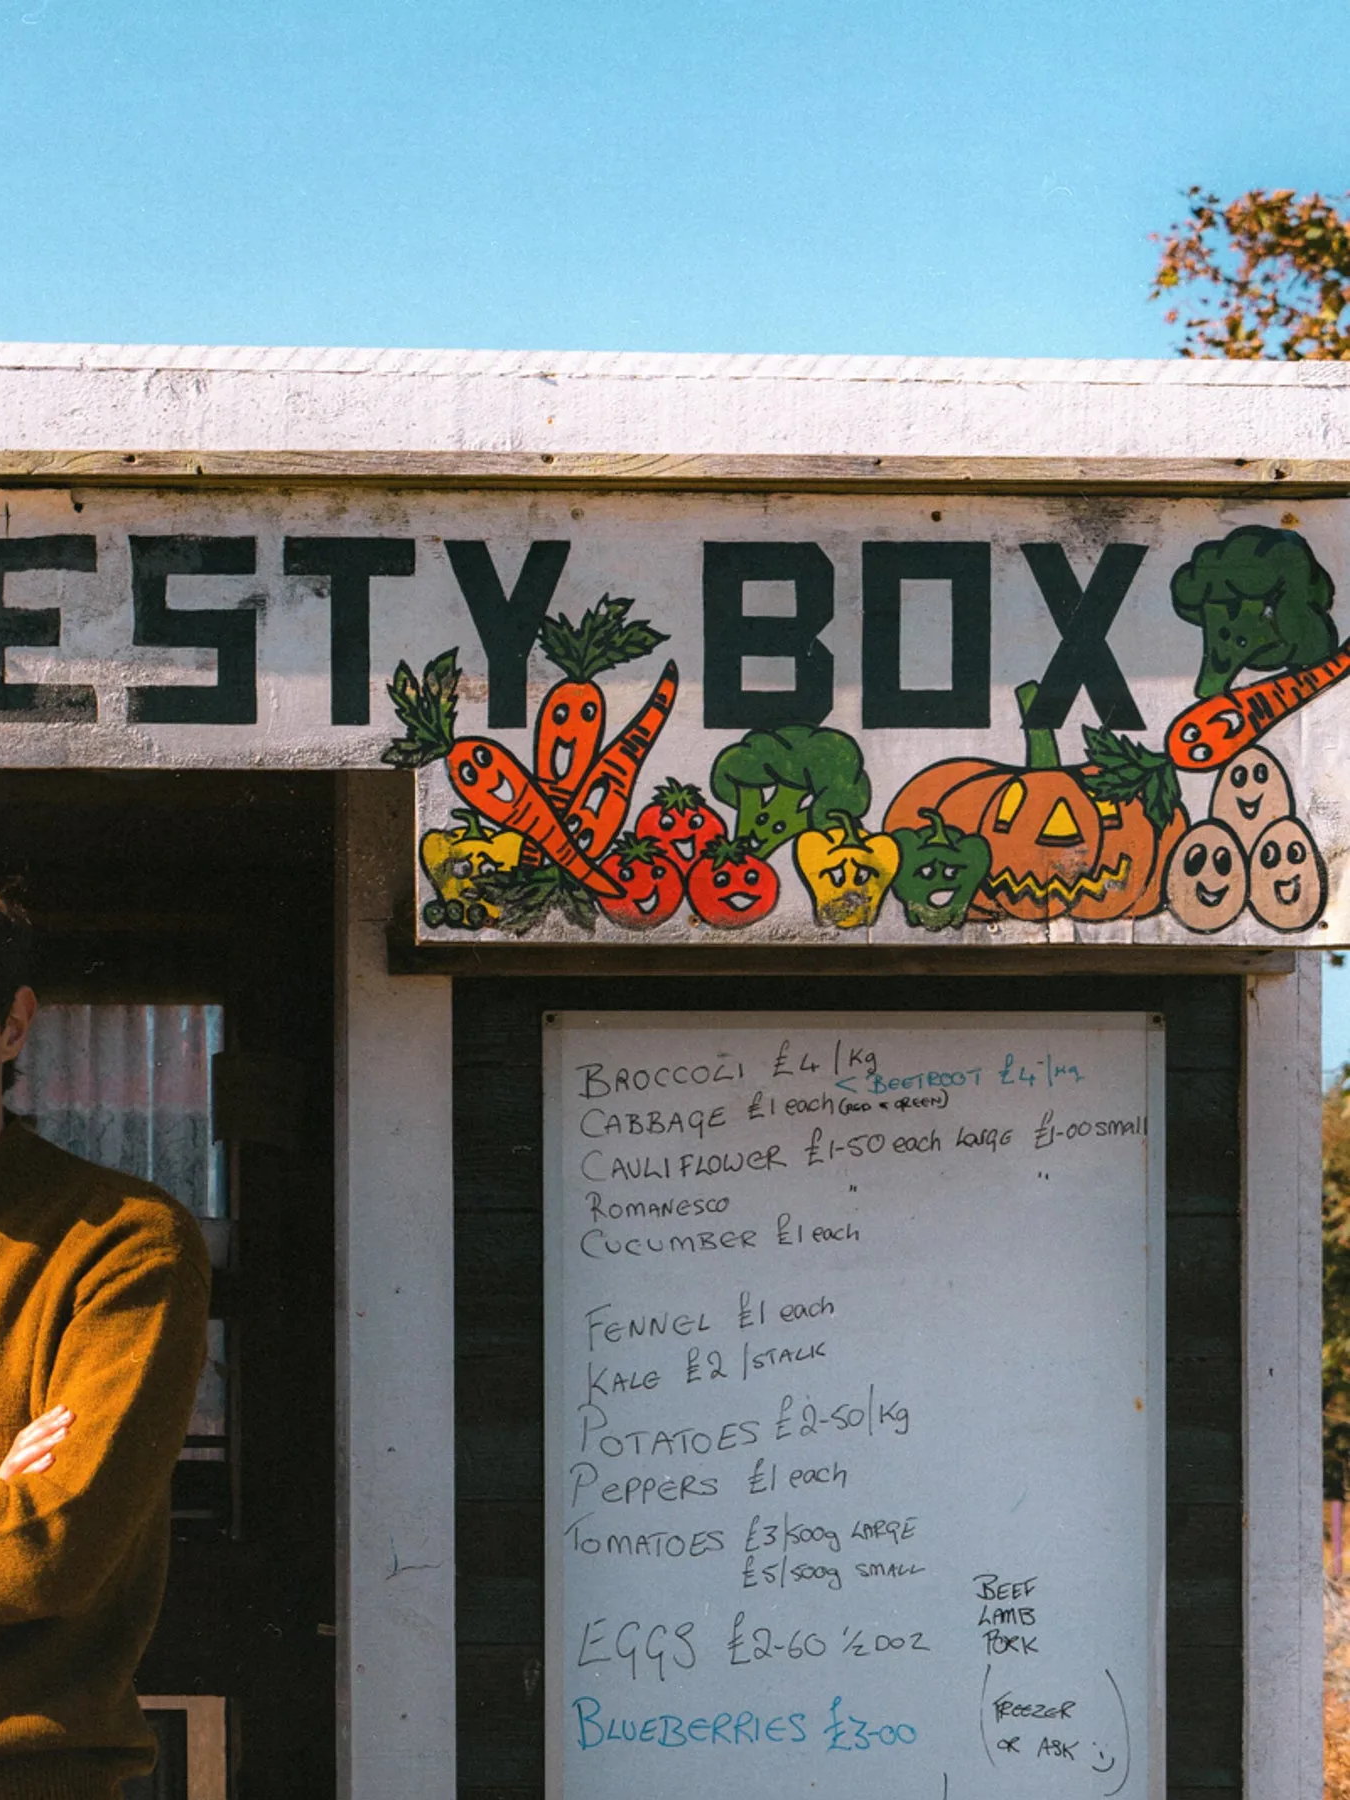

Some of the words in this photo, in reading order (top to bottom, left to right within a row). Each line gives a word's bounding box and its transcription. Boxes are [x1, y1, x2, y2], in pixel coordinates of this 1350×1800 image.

[703, 540, 1149, 730] BOX
[576, 1062, 744, 1099] BROCCOLI
[866, 1069, 982, 1095] BEETROOT
[580, 1107, 727, 1139] CABBAGE
[748, 1090, 775, 1120] £1
[785, 1092, 835, 1115] each
[581, 1144, 788, 1182] CAULIFLOWER
[893, 1125, 942, 1152] each
[585, 1191, 730, 1223] ROMANESCO
[580, 1228, 757, 1259] CUCUMBER
[776, 1212, 802, 1246] £1
[811, 1222, 860, 1243] each
[584, 1303, 711, 1352] FENNEL
[737, 1290, 766, 1329] £1
[779, 1296, 835, 1323] each
[587, 1361, 662, 1405] KALE
[577, 1403, 760, 1458] POTATOES
[570, 1463, 718, 1507] PEPPERS
[748, 1458, 779, 1496] £1
[788, 1465, 848, 1490] each
[563, 1511, 725, 1558] TOMATOES
[851, 1516, 919, 1545] LARGE
[854, 1561, 926, 1578] SMALL
[973, 1573, 1039, 1601] BEEF
[977, 1604, 1036, 1626] LAMB
[577, 1617, 697, 1682] EGGS
[728, 1611, 828, 1666] £2-60
[982, 1628, 1039, 1655] PORK
[573, 1696, 808, 1750] BLUEBERRIES
[823, 1696, 918, 1752] £3-00
[997, 1736, 1021, 1754] OR
